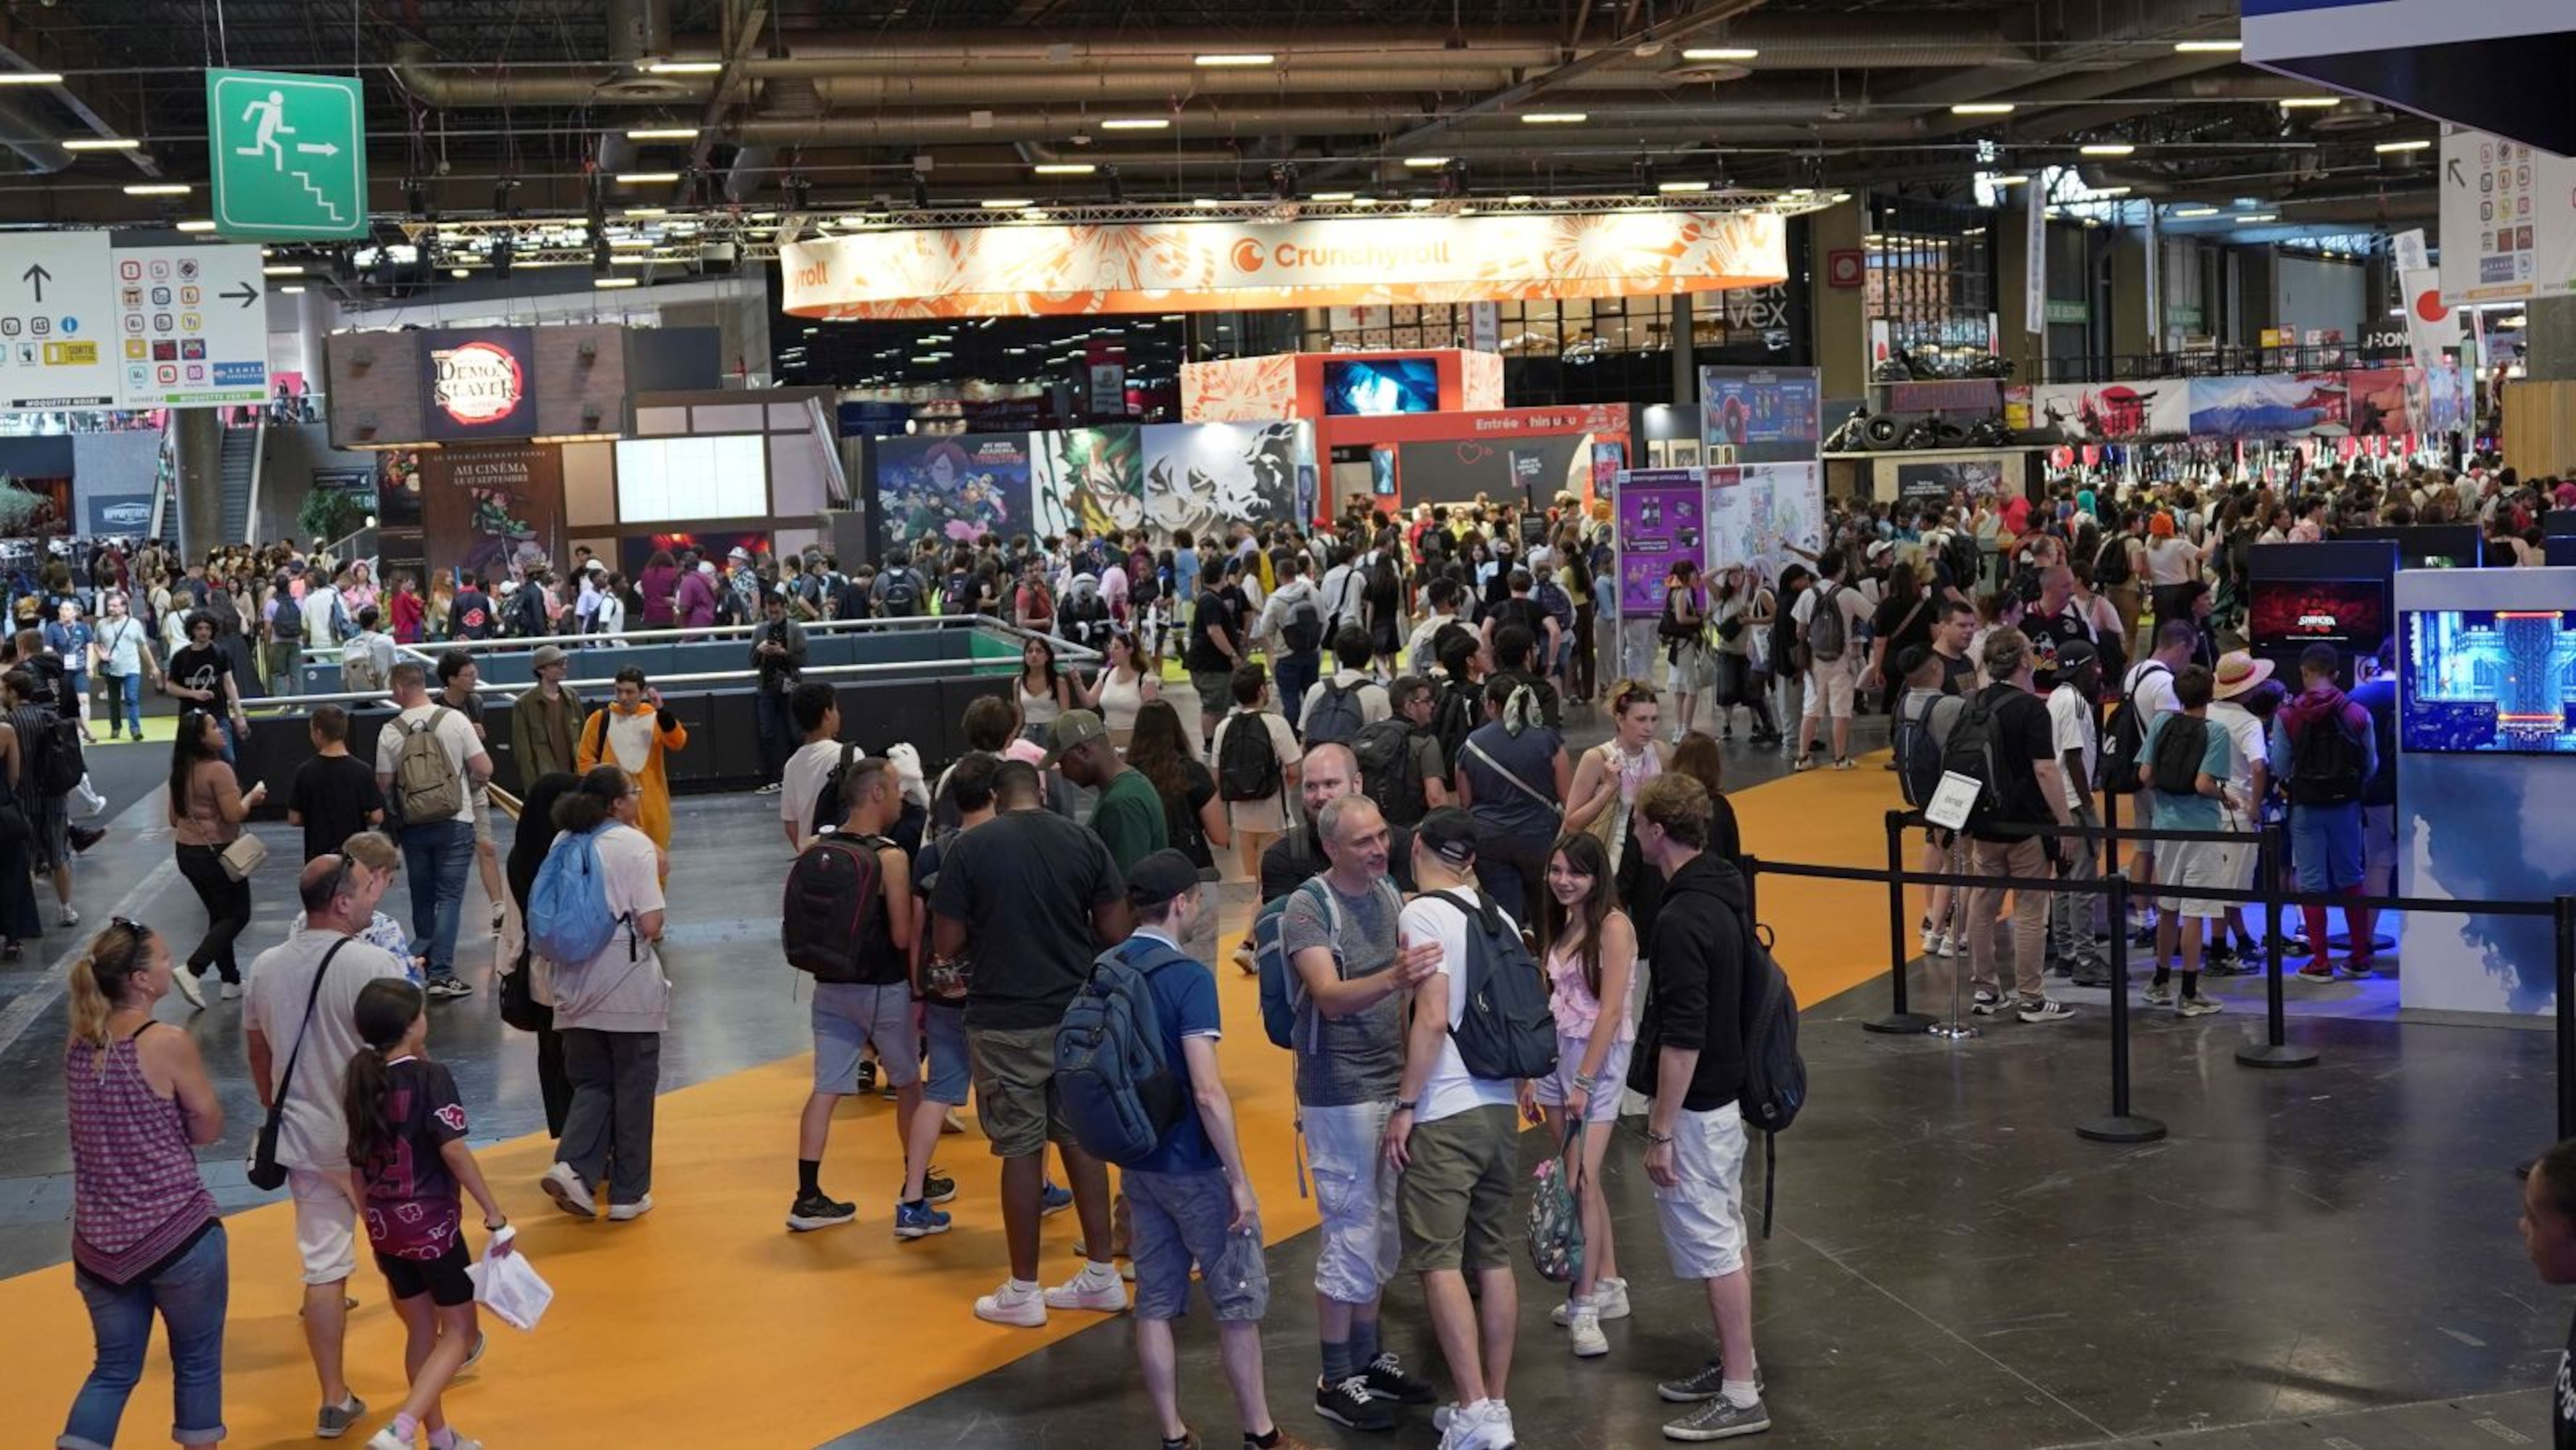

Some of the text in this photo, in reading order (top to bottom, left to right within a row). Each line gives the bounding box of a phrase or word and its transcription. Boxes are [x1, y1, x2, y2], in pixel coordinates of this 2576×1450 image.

[1728, 301, 1788, 329] vex
[435, 359, 516, 381] DEMON
[435, 378, 520, 405] SLAYER
[25, 398, 70, 408] MOQUETTE
[73, 397, 99, 406] NOIRE
[1476, 417, 1519, 431] Entrée
[453, 461, 528, 476] AU CINÉMA
[477, 473, 529, 484] SEPTEMBRE
